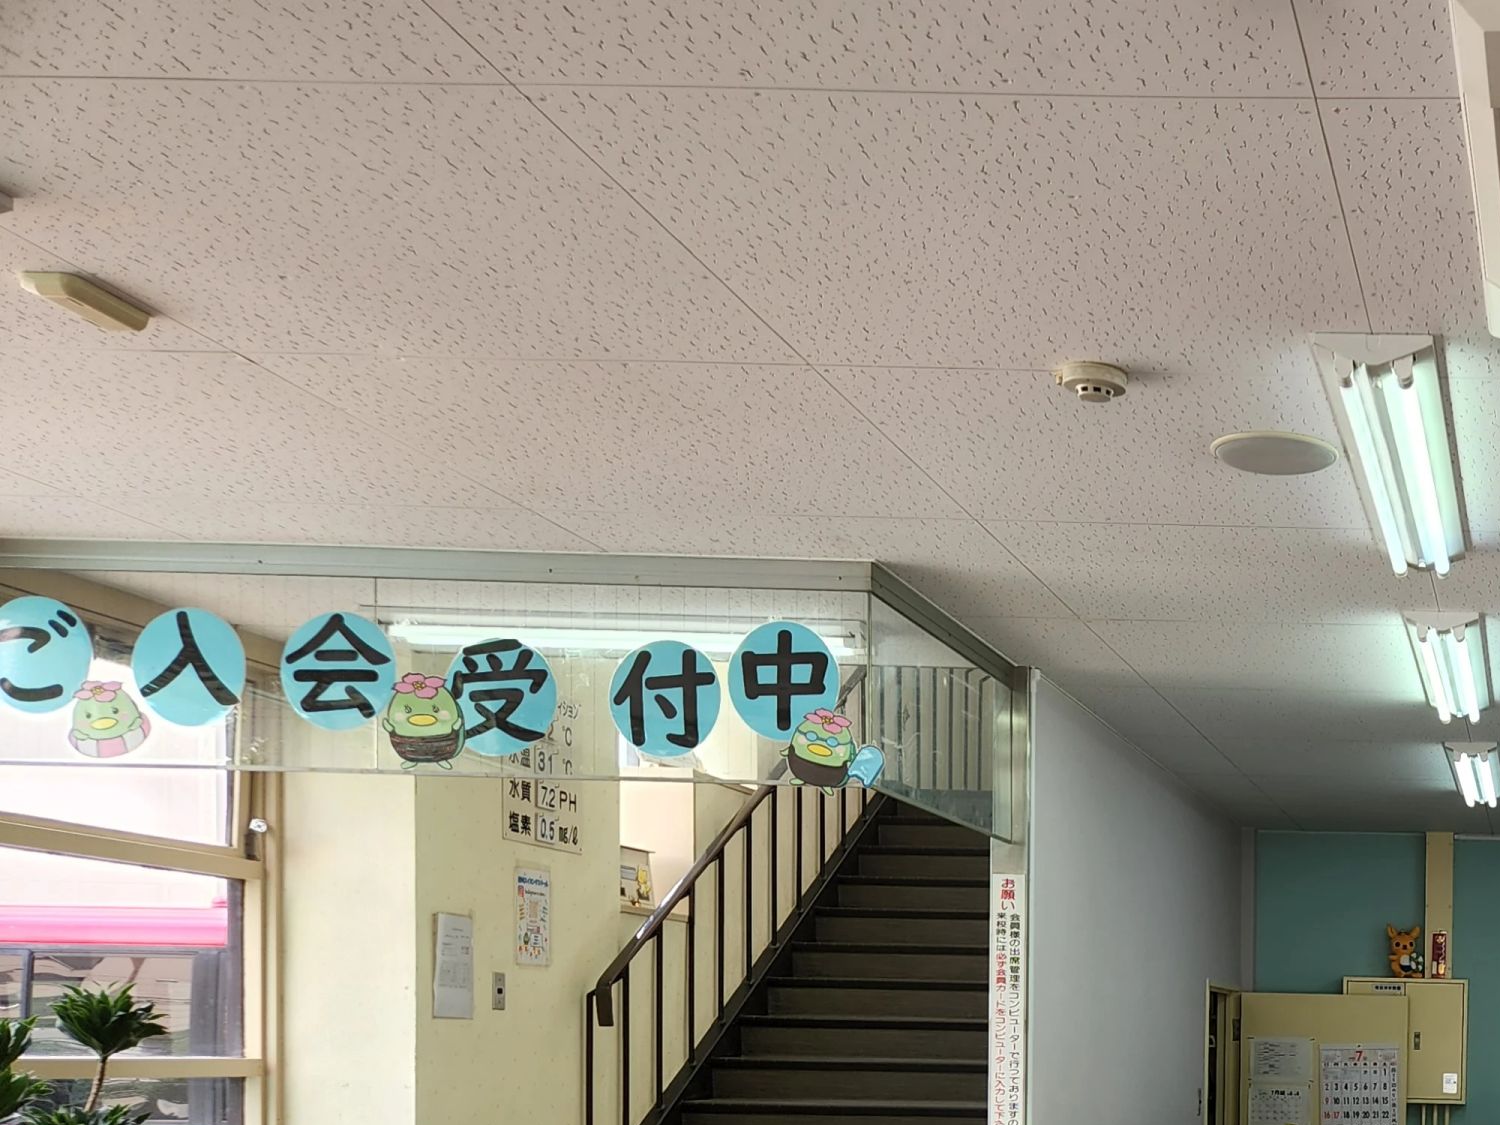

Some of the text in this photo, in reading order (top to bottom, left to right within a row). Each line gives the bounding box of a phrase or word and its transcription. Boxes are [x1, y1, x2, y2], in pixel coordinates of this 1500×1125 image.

[560, 790, 577, 813] PH
[1001, 878, 1016, 911] お願い
[1325, 1082, 1387, 1091] 2 3 4 5 6 7 8
[1325, 1097, 1389, 1105] 9 10 11 12 13 14 15
[1324, 1111, 1389, 1119] 16 17 18 19 20 21 22
